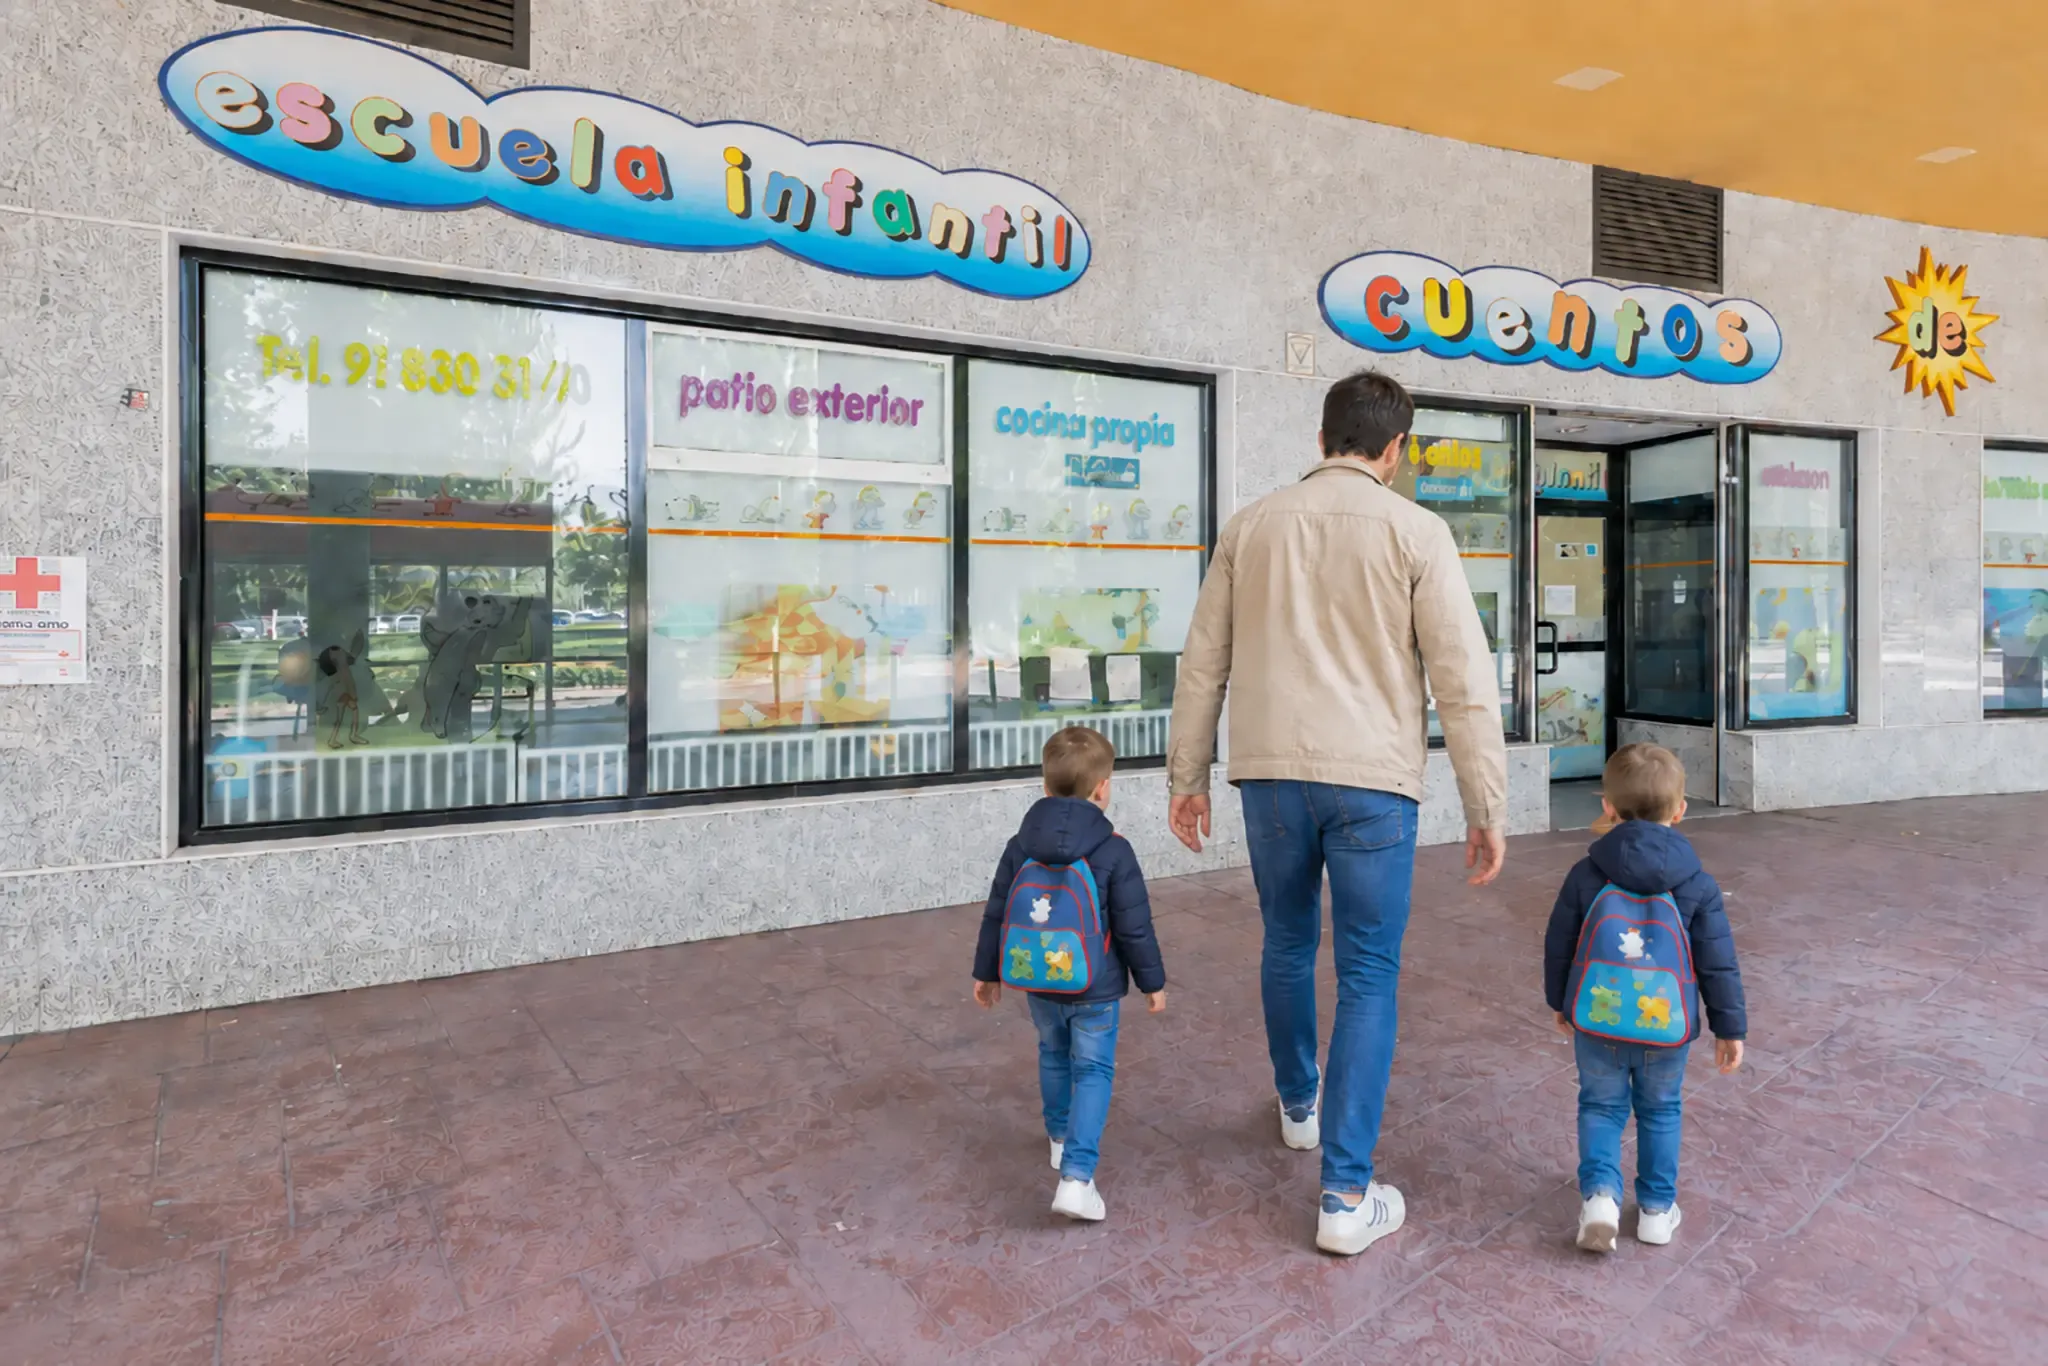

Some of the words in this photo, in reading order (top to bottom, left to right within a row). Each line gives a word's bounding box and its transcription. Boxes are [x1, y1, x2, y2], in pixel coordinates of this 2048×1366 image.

[194, 71, 668, 199] escuela
[723, 146, 1073, 269] infantil
[1908, 296, 1966, 358] de
[256, 335, 331, 385] Tel.
[344, 342, 388, 389] 91
[401, 348, 480, 397] 830
[680, 371, 777, 419] patio
[788, 382, 924, 427] exterior
[995, 401, 1086, 440] cocina
[1091, 412, 1175, 453] propia
